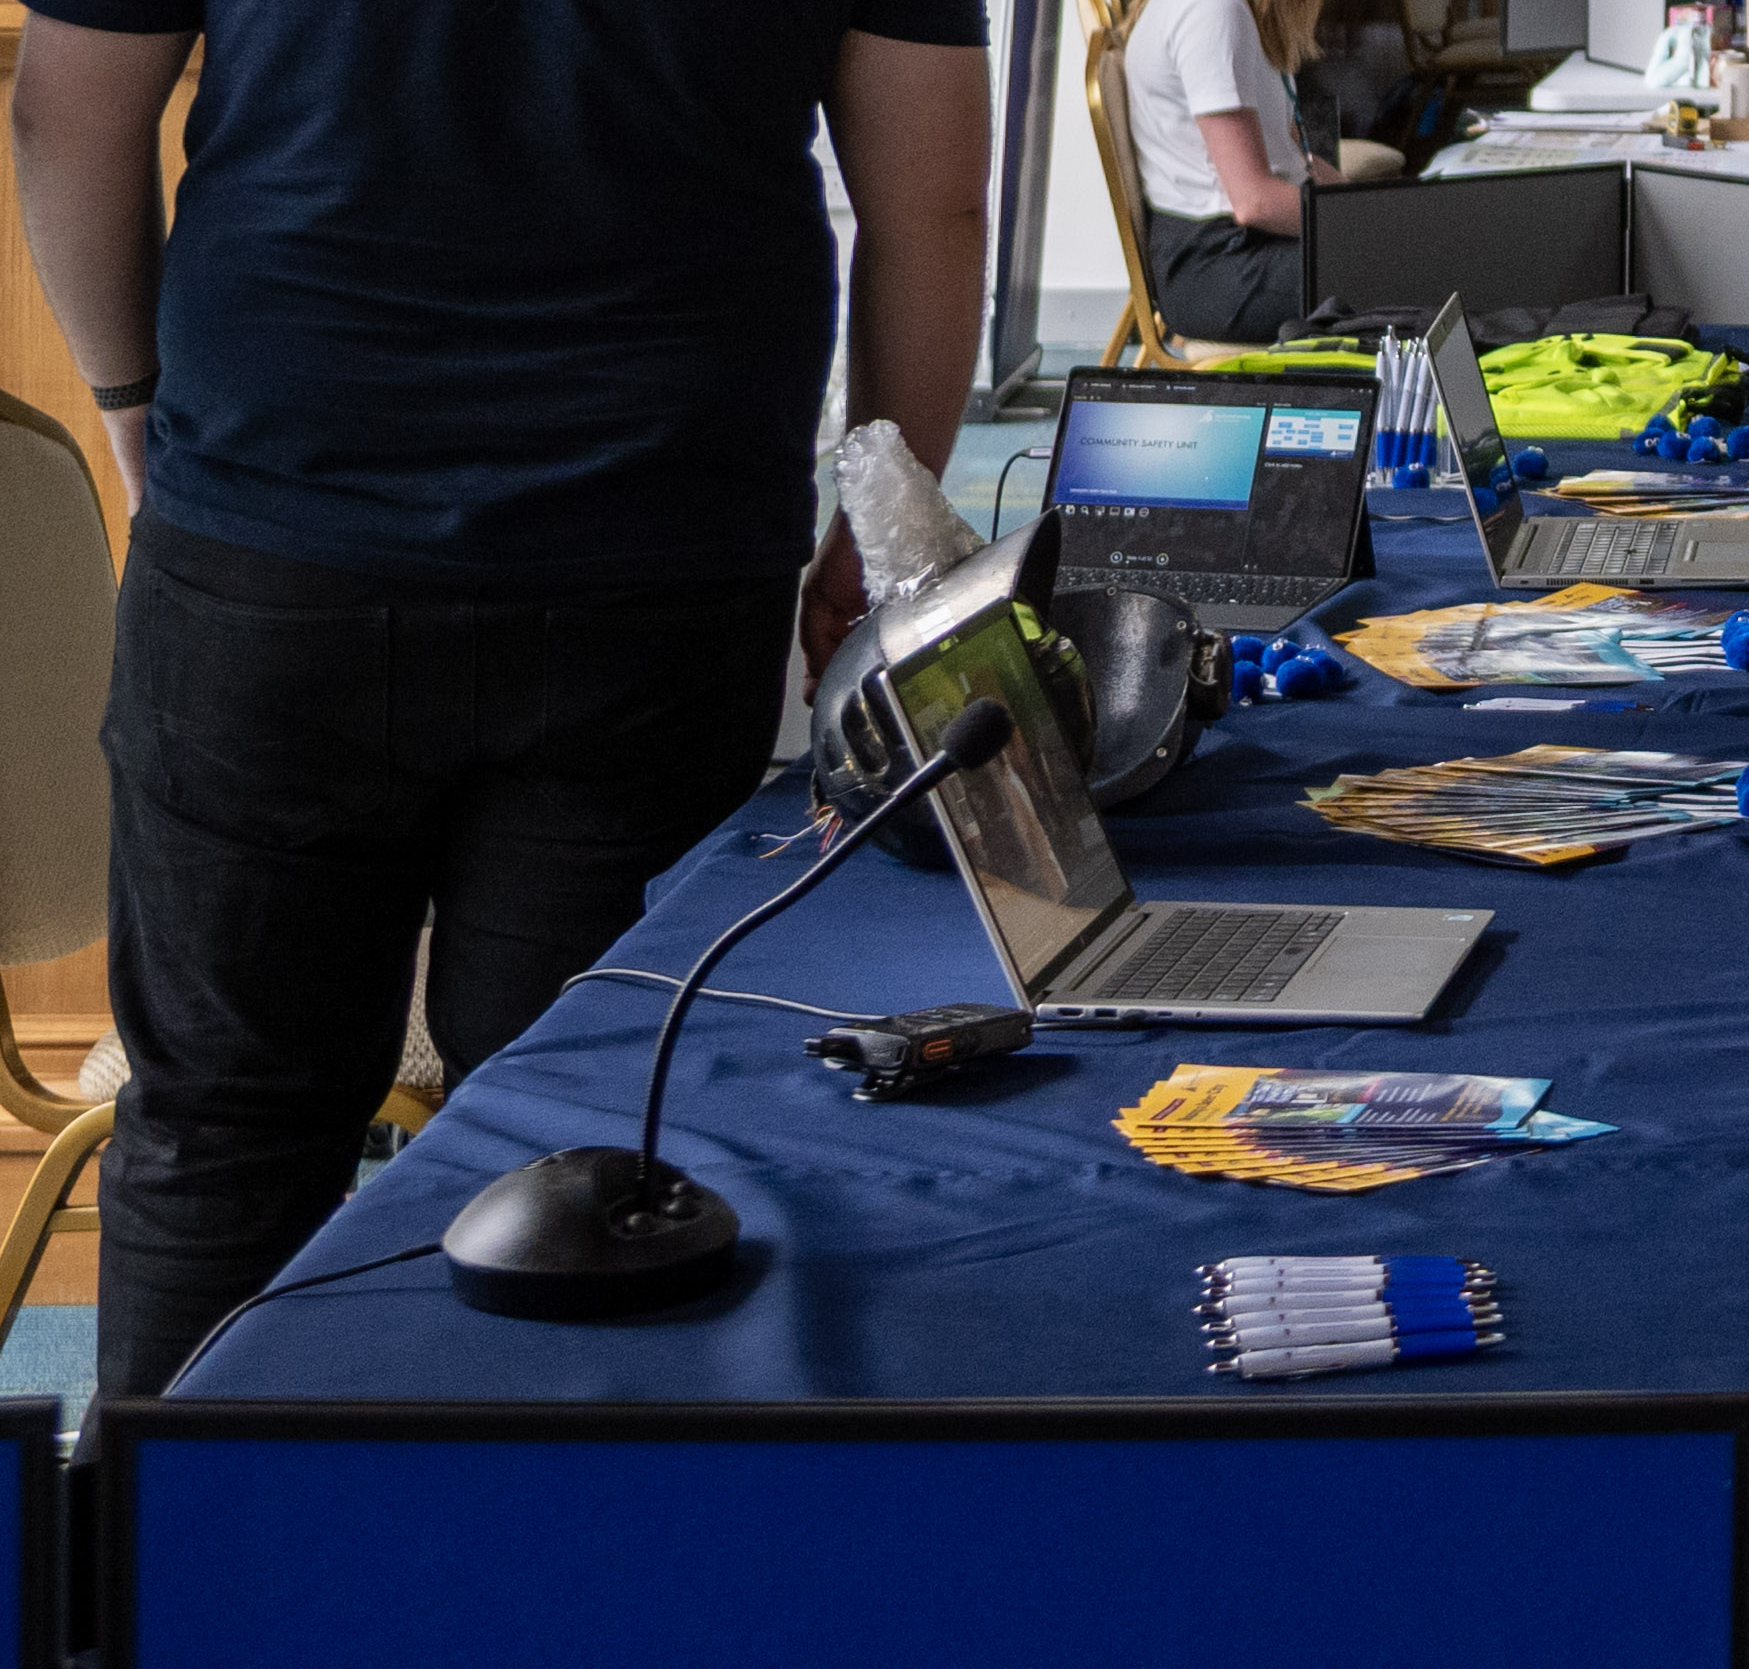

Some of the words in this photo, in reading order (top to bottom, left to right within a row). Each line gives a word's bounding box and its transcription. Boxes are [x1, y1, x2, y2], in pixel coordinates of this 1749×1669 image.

[1079, 435, 1139, 448] COMMUNITY
[1141, 438, 1175, 449] SAFETY
[1176, 439, 1199, 450] UNIT
